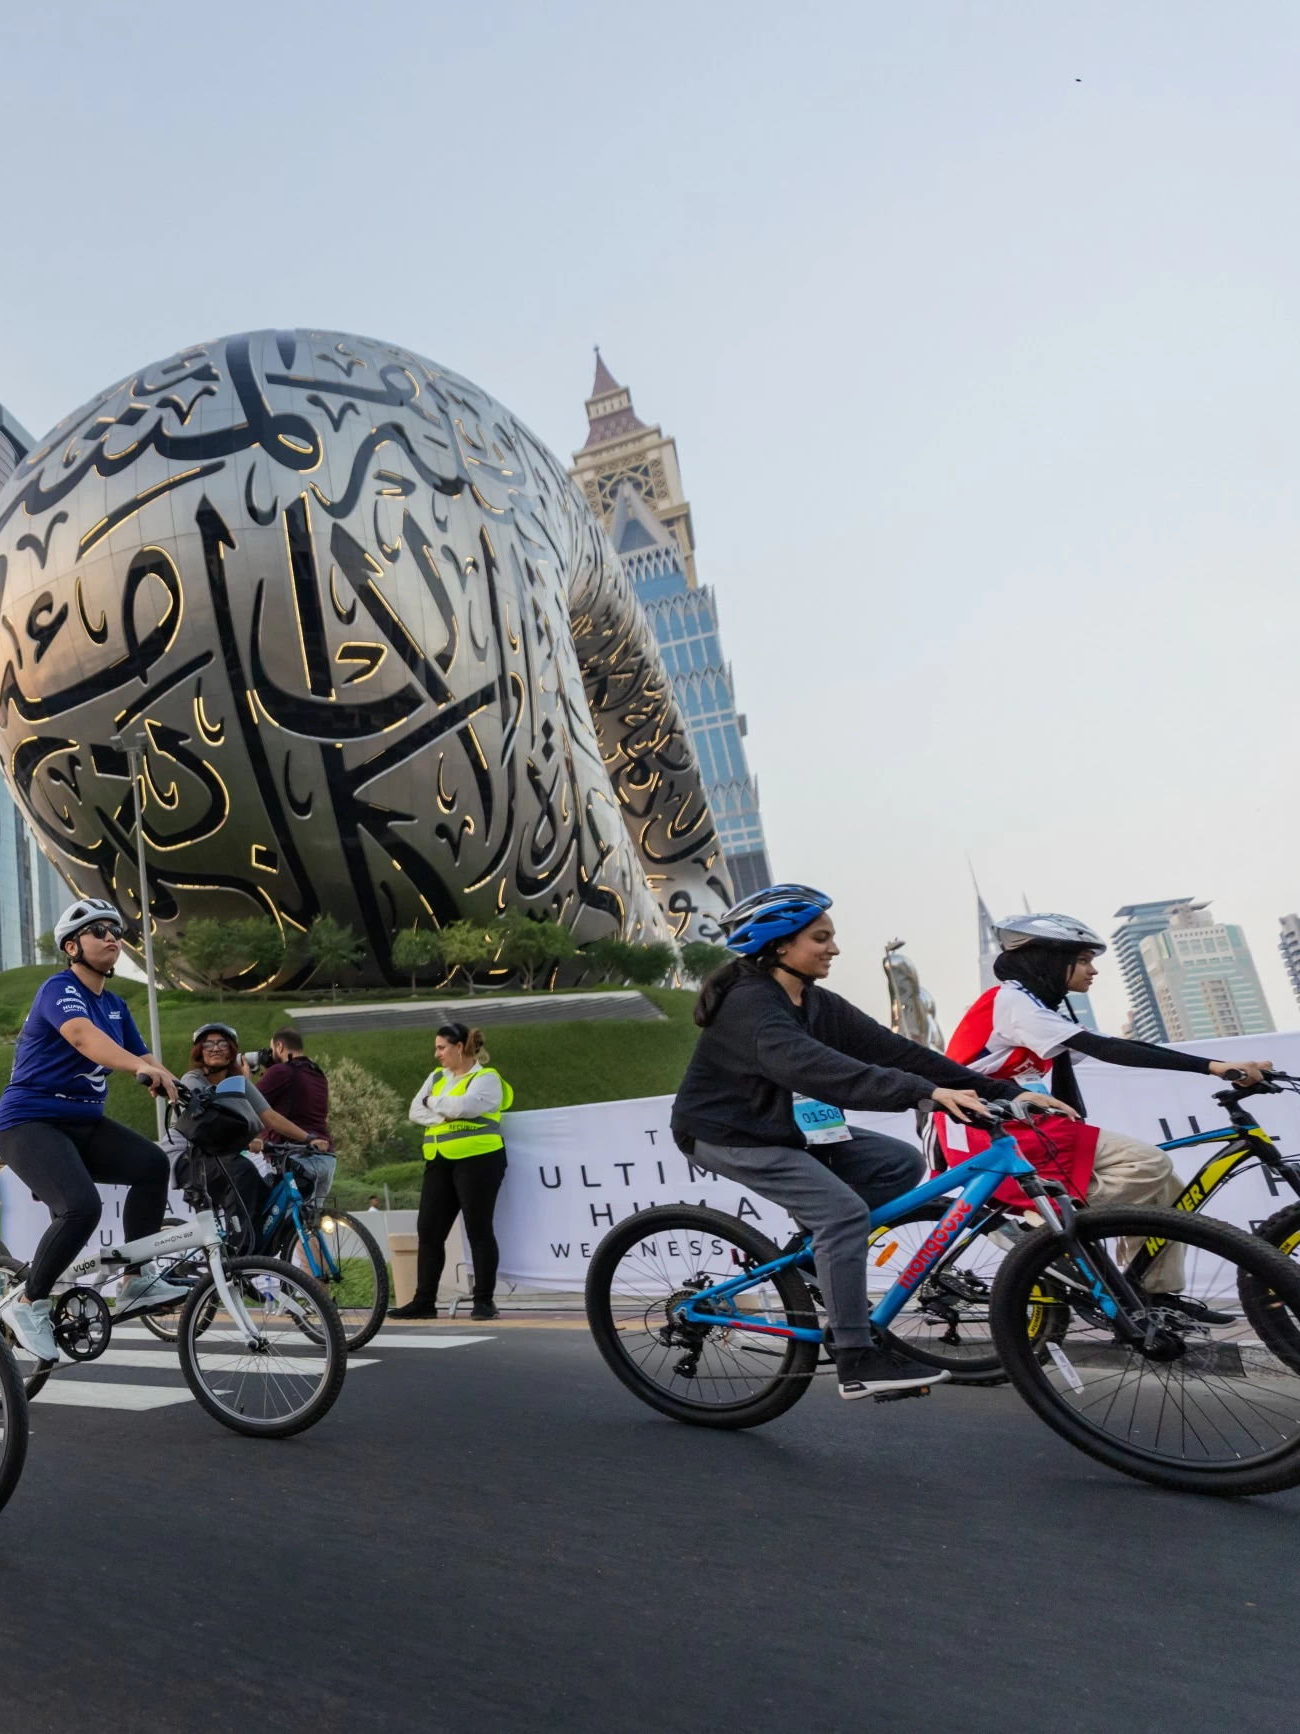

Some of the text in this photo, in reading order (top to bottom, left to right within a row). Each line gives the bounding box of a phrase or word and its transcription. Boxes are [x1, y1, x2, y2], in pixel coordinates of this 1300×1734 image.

[802, 1107, 841, 1124] 01508
[448, 1123, 478, 1131] SECURIT
[539, 1160, 718, 1190] ULTIM
[154, 1234, 183, 1248] DAHON
[551, 1238, 723, 1258] WENESS
[896, 1198, 973, 1290] mongoose
[73, 1259, 96, 1275] vybe
